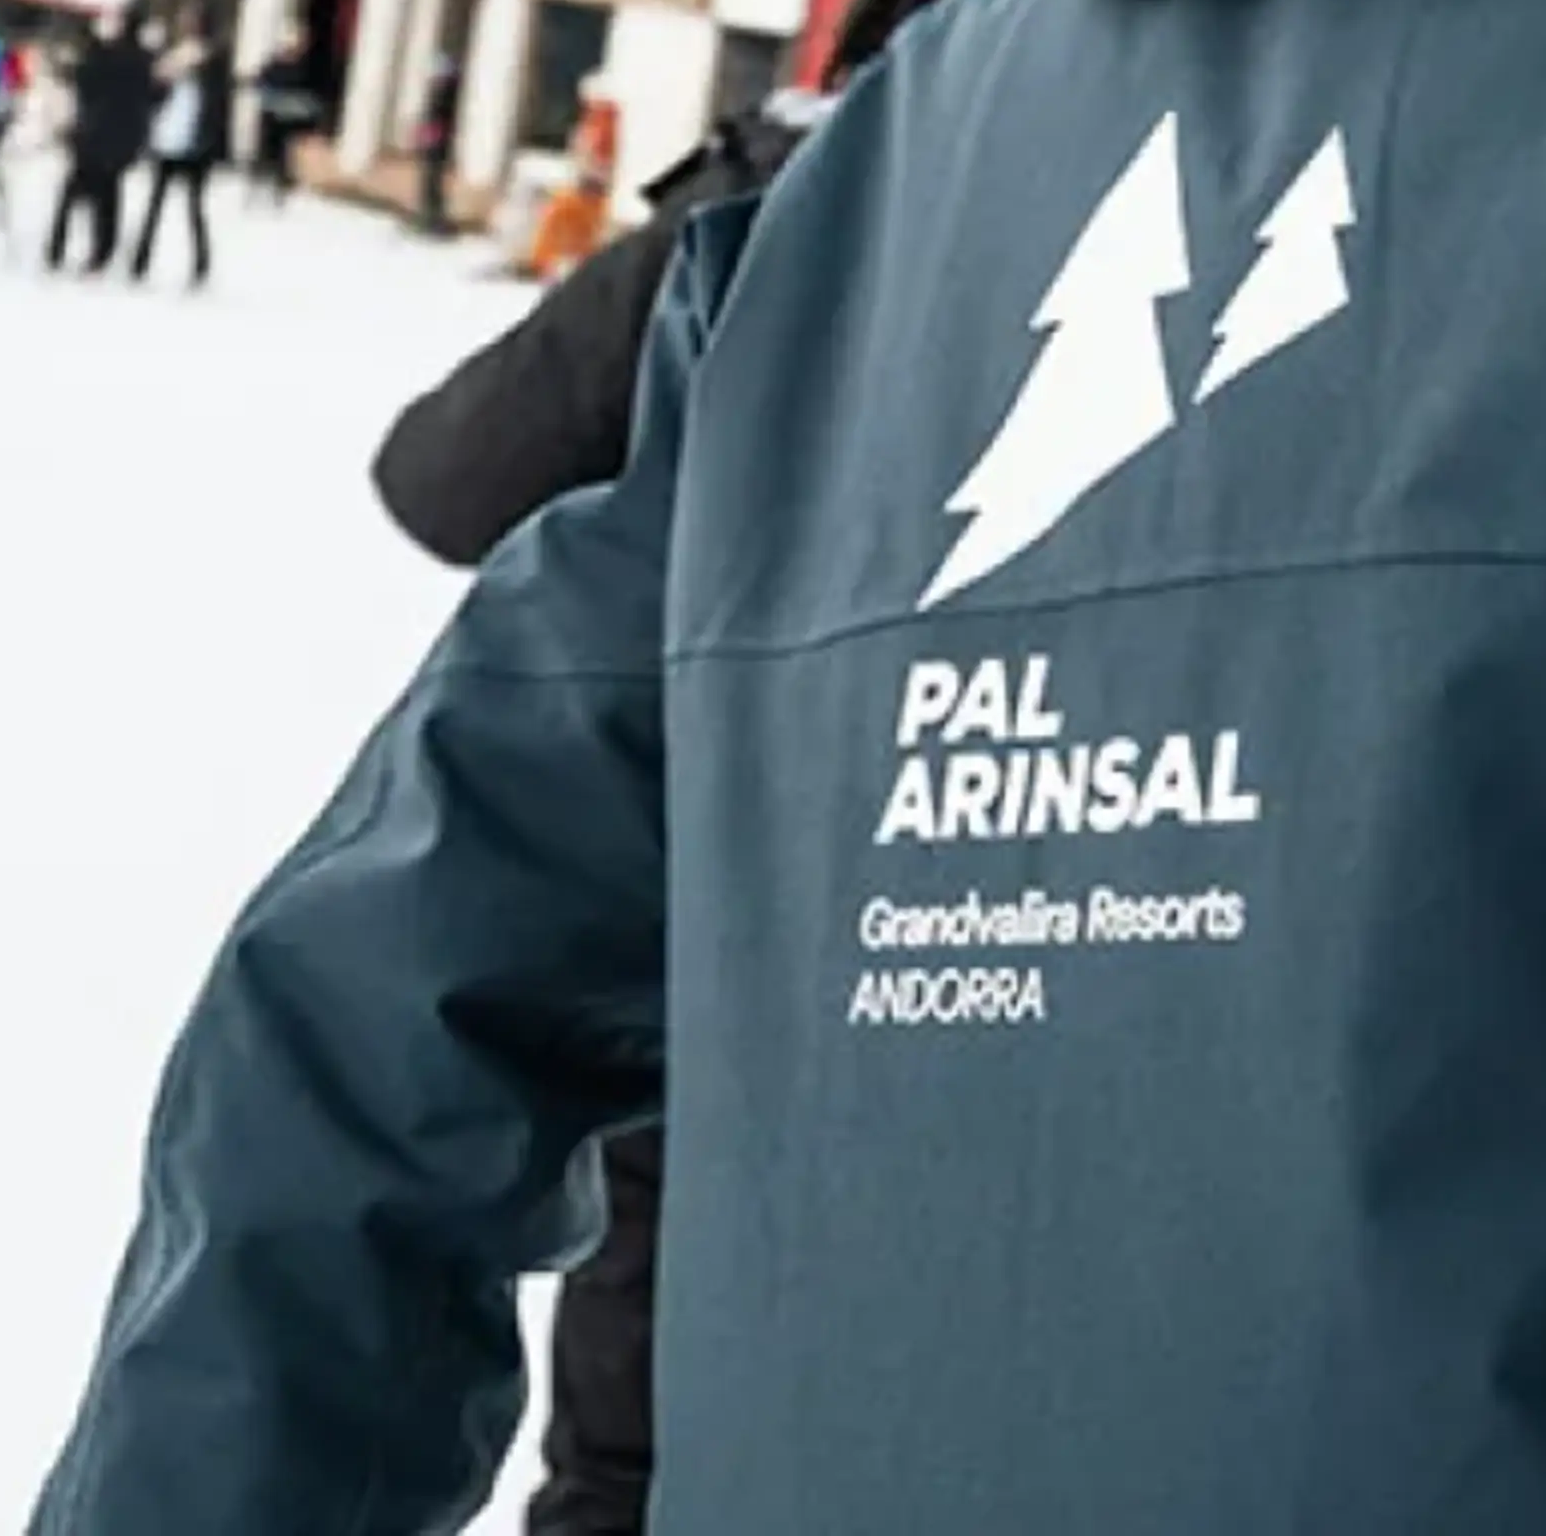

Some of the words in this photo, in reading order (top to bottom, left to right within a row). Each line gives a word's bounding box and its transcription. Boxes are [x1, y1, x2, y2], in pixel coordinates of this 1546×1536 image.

[895, 653, 1065, 748] PAL
[872, 729, 1262, 845] ARINSAL
[858, 888, 1080, 952] Grandvalira
[1085, 885, 1246, 943] Resorts
[846, 966, 1046, 1025] ANDORRA
